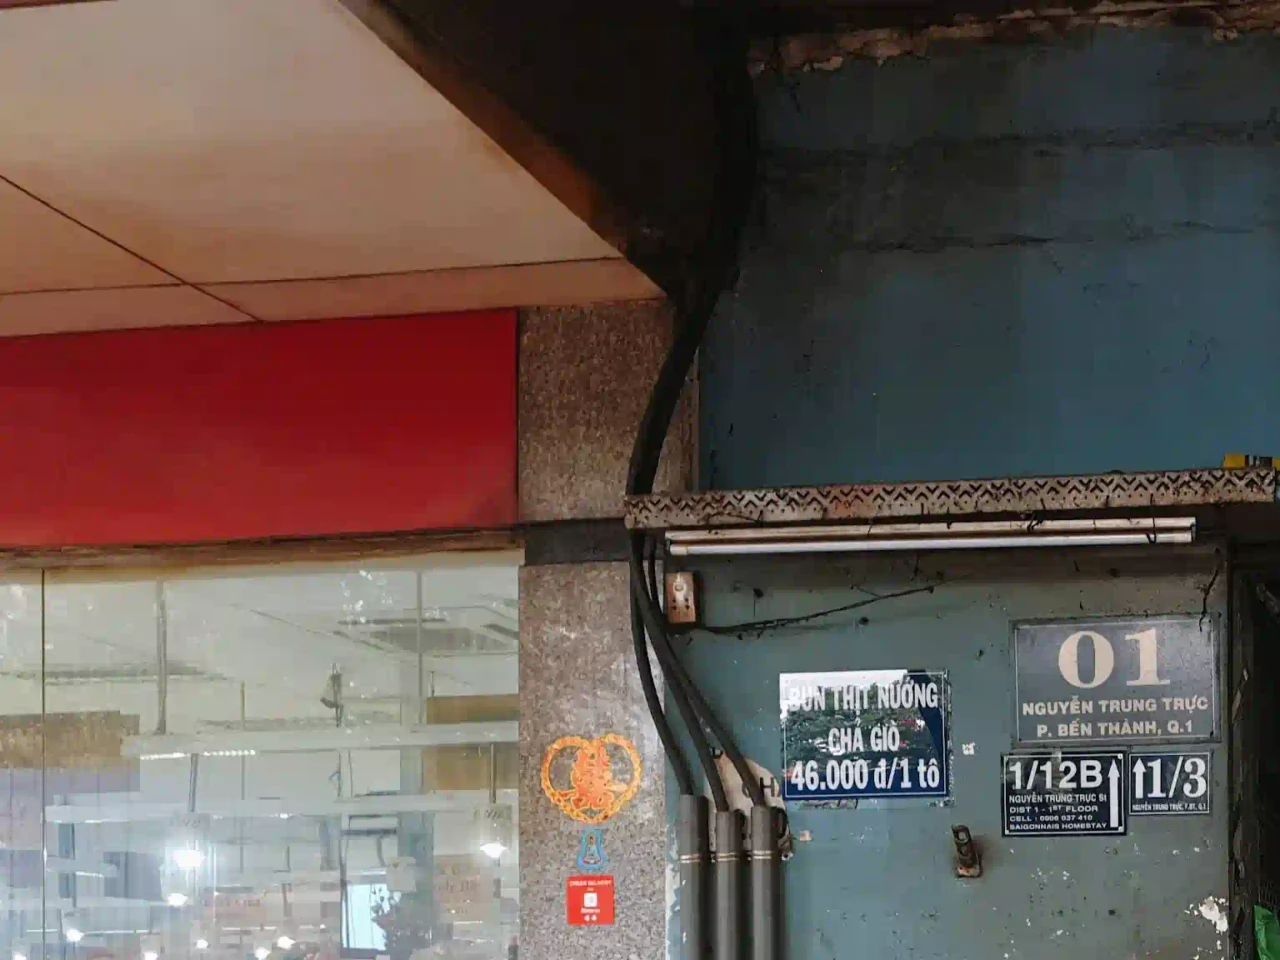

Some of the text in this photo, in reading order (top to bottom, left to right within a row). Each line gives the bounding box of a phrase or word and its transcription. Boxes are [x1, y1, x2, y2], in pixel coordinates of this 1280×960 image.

[1058, 626, 1171, 689] 01
[1022, 694, 1209, 716] NGUYỄN TRUNG TRỰC
[1036, 724, 1053, 738] P.
[1058, 717, 1092, 737] BẾN
[1167, 720, 1193, 734] Q.1
[790, 758, 869, 791] 46.000
[917, 758, 940, 789] tô
[1009, 759, 1103, 790] 1/12B
[1147, 755, 1207, 798] 1/3
[1010, 806, 1031, 814] DIST
[1066, 805, 1099, 813] FLOOR
[1045, 794, 1073, 803] TRUNG
